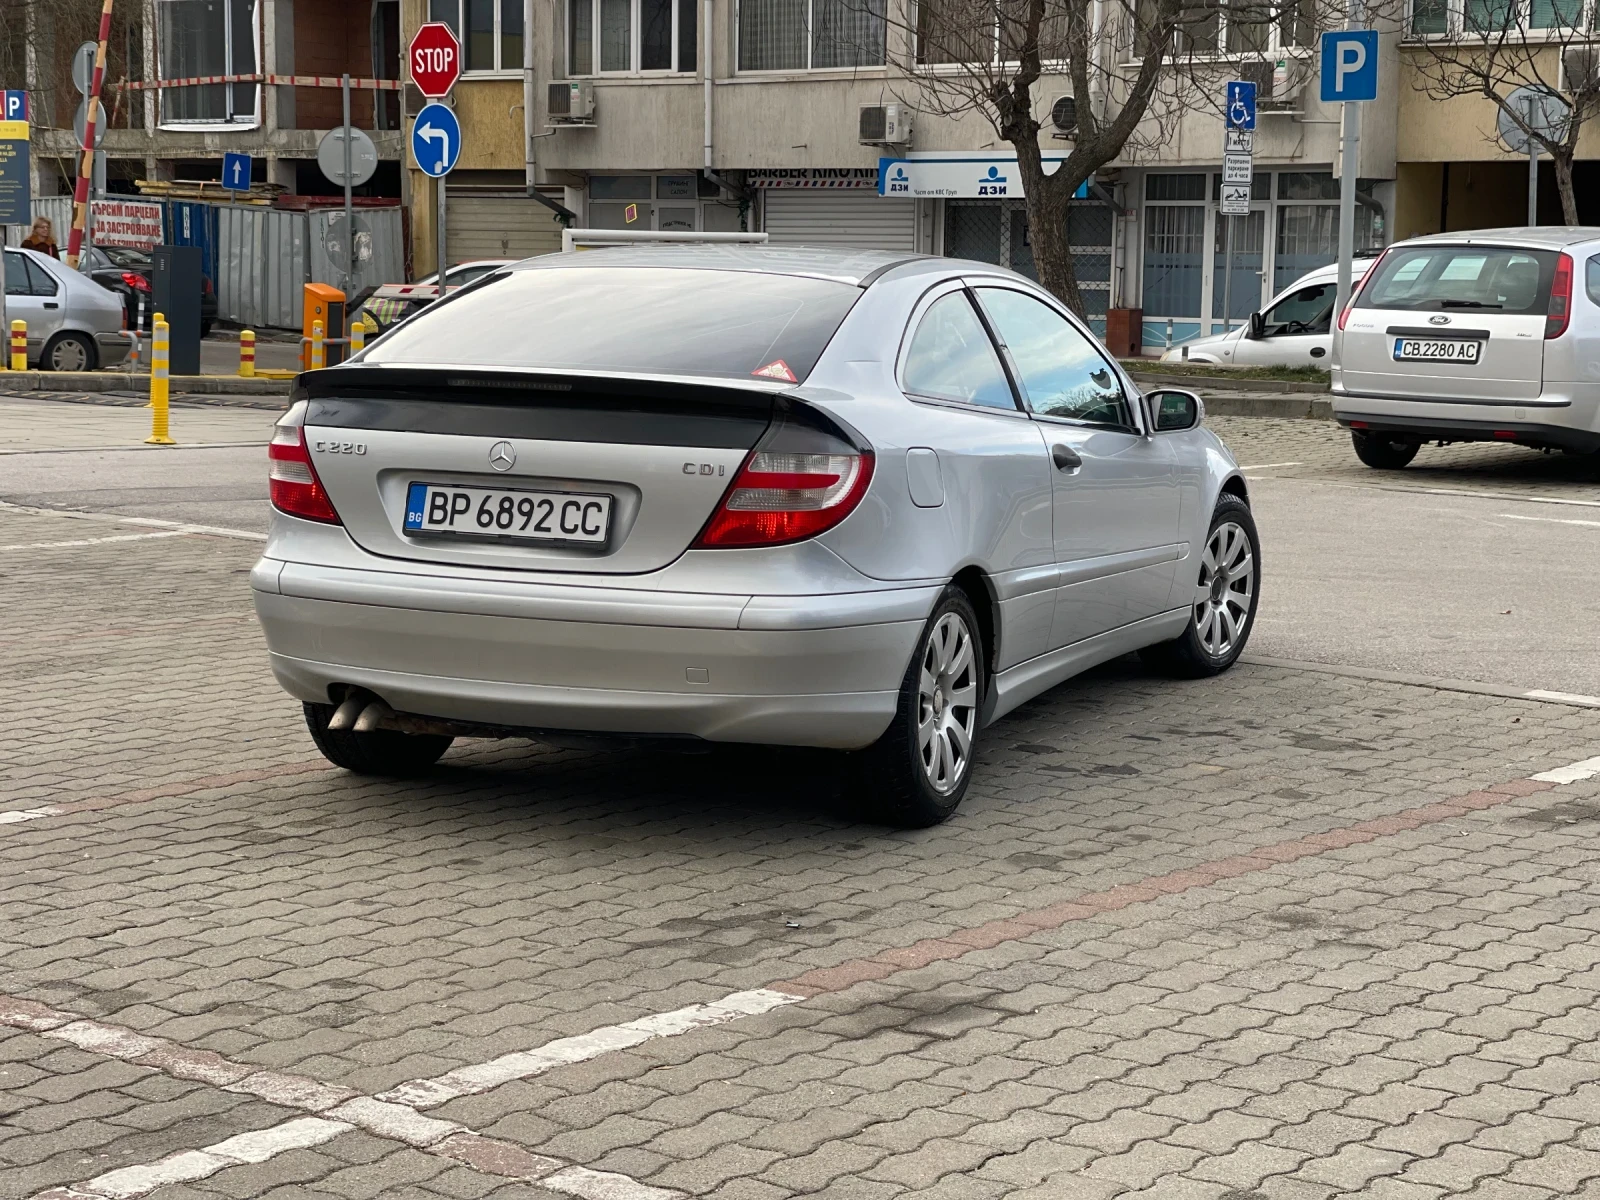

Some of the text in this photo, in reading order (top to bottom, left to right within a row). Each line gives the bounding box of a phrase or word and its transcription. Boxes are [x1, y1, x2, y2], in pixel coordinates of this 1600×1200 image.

[415, 47, 454, 73] STOP
[1335, 40, 1367, 92] P
[9, 96, 20, 116] P
[1227, 157, 1250, 165] Разрешено
[890, 183, 909, 192] ДЗИ
[978, 186, 1007, 195] ДЗИ
[91, 203, 160, 220] ТЪРСИМ ПАРЦЕЛИ
[96, 221, 162, 237] ЗА ЗАСТРОЯВАНЕ
[1456, 346, 1475, 359] AC
[682, 462, 725, 477] CDI
[408, 511, 422, 523] BG
[427, 491, 603, 536] BP 6892 CC
